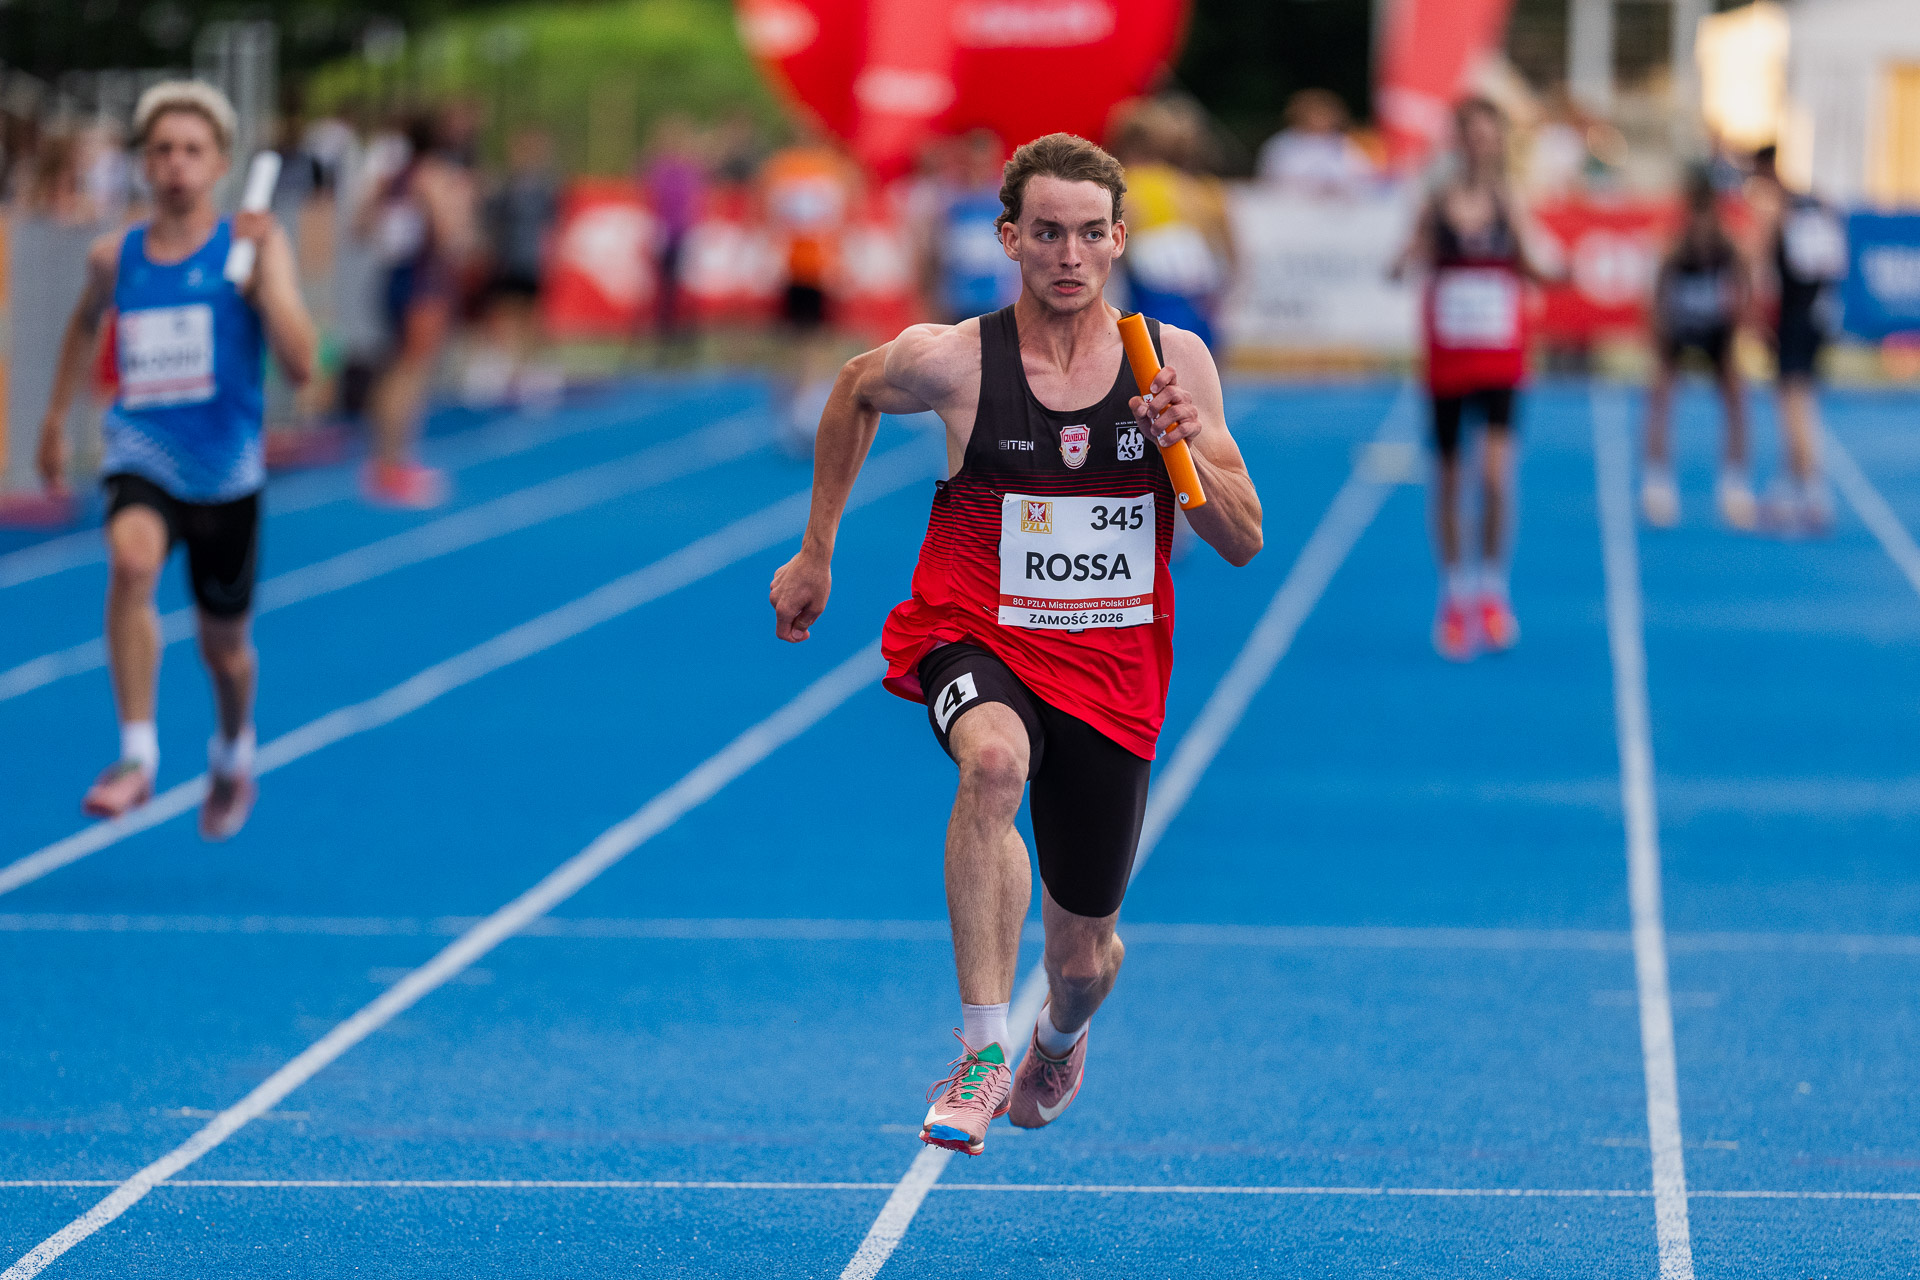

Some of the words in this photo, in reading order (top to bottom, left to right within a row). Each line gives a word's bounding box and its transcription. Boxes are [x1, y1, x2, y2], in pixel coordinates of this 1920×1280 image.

[1022, 521, 1050, 533] PZLA
[1090, 504, 1144, 531] 345
[1025, 551, 1132, 582] ROSSA
[1012, 597, 1026, 606] 80.
[1027, 599, 1047, 608] PZLA
[1048, 601, 1099, 610] Mistrzostwa
[1100, 599, 1125, 608] Polski
[1126, 597, 1141, 606] U20
[1029, 612, 1089, 626] ZAMOŚĆ
[1091, 612, 1124, 624] 2026
[942, 681, 966, 717] 4
